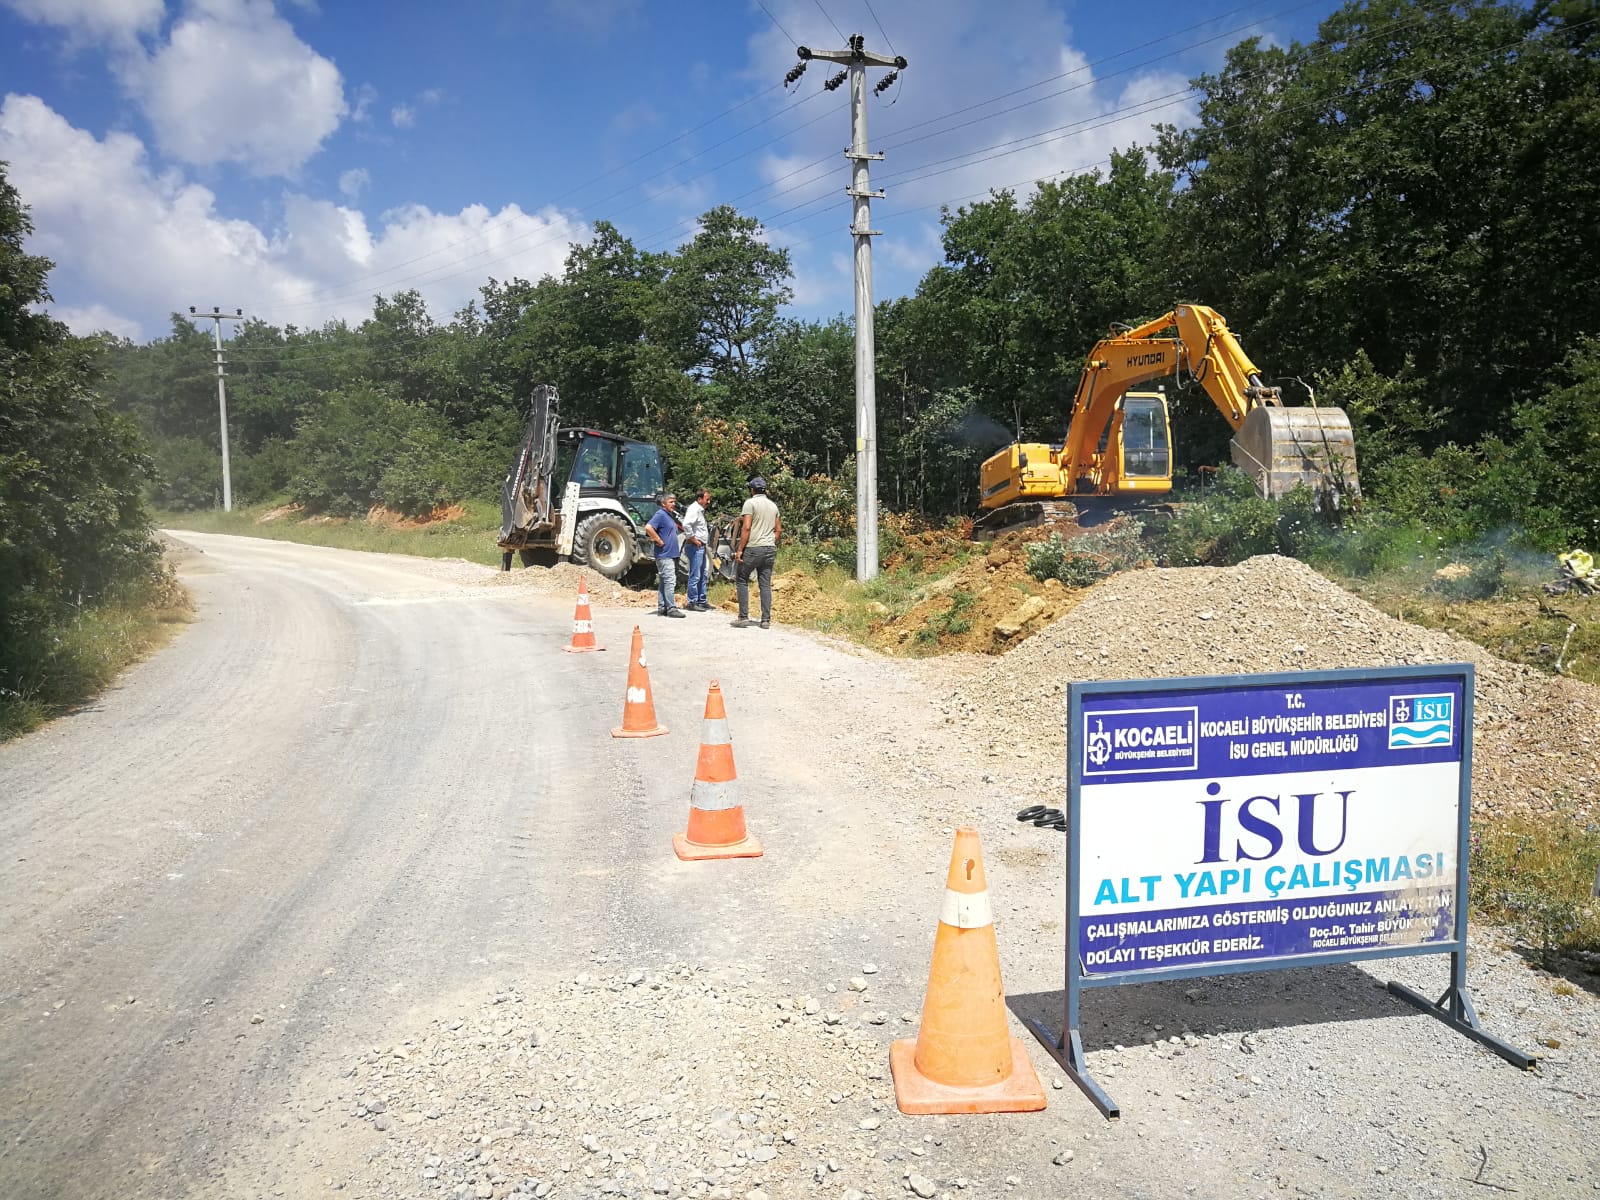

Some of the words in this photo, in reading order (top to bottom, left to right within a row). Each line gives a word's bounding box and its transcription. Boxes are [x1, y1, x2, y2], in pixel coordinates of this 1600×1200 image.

[1127, 352, 1165, 367] HYUNDAI
[1286, 694, 1305, 709] T.C.
[1416, 701, 1450, 721] İSU
[1115, 720, 1193, 747] KOCAELİ
[1200, 716, 1249, 738] KOCAELİ
[1252, 713, 1323, 735] BÜYÜKŞEHİR
[1325, 708, 1387, 729] BELEDİYESİ
[1230, 741, 1249, 760] İSU
[1252, 739, 1287, 758] GENEL
[1290, 733, 1359, 755] MÜDÜRLÜĞÜ
[1194, 782, 1356, 864] İSU
[1094, 875, 1162, 905] ALT
[1174, 867, 1251, 898] YAPI
[1264, 852, 1444, 898] ÇALIŞMASI
[1087, 911, 1210, 941] ÇALIŞMALARIMIZA
[1212, 905, 1289, 926] GÖSTERMİŞ
[1292, 899, 1371, 921] OLDUĞUNUZ
[1349, 921, 1375, 935] Tahir
[1086, 947, 1136, 965] DOLAYI
[1139, 939, 1210, 962] TEŞEKKÜR
[1213, 933, 1264, 953] EDERİZ.
